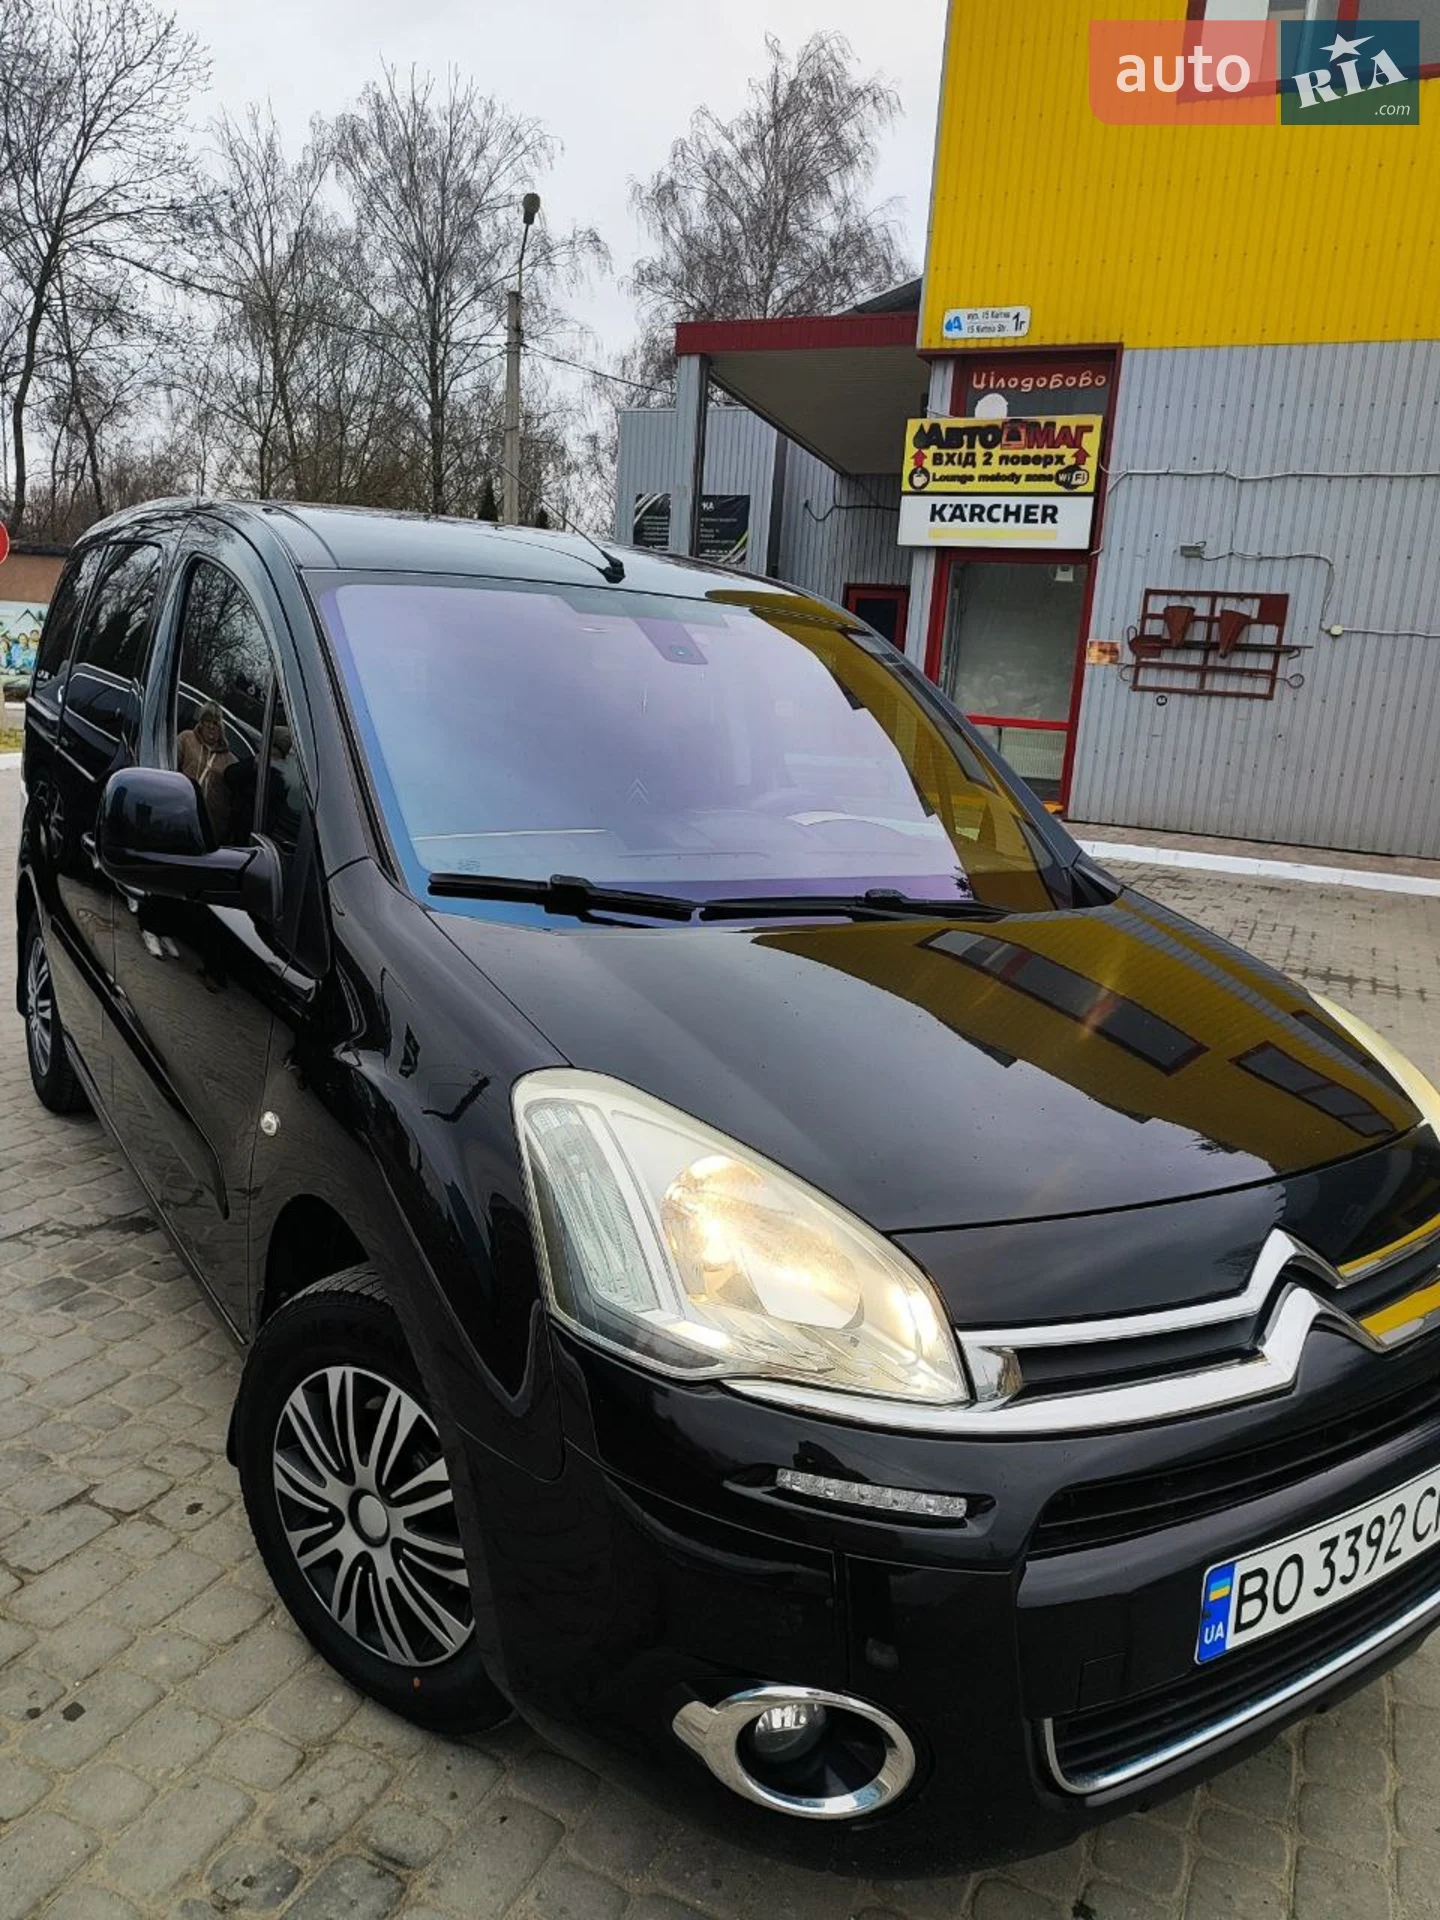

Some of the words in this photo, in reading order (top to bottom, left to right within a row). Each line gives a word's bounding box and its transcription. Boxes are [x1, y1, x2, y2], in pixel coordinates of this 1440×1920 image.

[932, 453, 976, 468] ВХІД
[983, 452, 993, 465] 2
[999, 456, 1066, 467] поверх
[929, 503, 1059, 524] KÄRCHER
[1234, 1553, 1304, 1635] BO
[1313, 1503, 1406, 1597] 3392
[1204, 1621, 1225, 1645] UA
